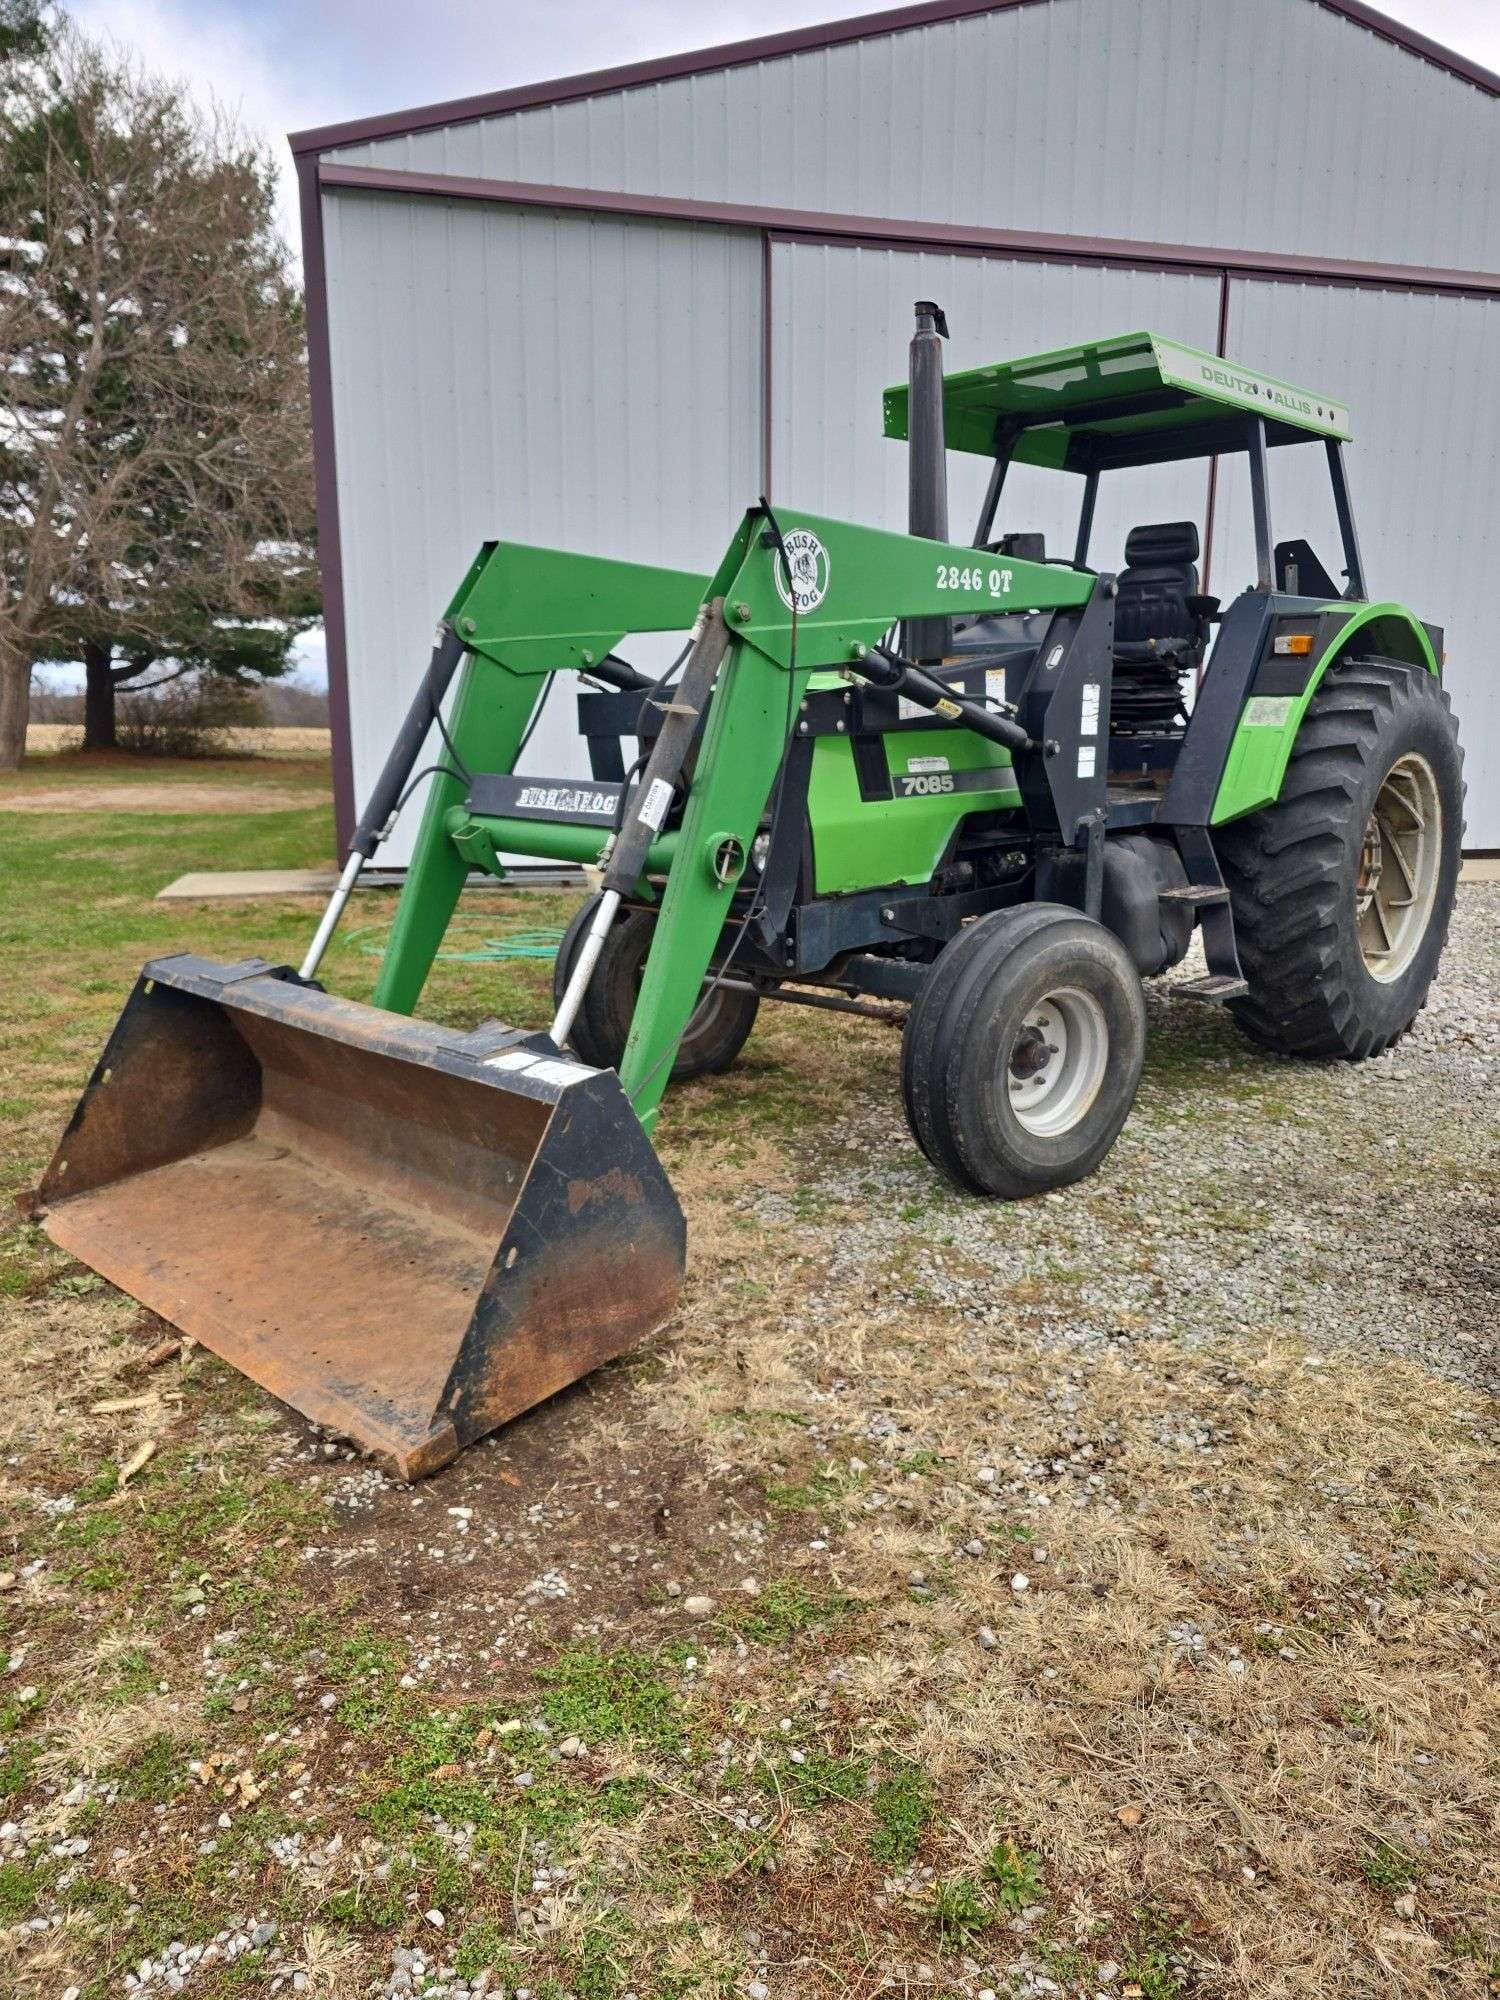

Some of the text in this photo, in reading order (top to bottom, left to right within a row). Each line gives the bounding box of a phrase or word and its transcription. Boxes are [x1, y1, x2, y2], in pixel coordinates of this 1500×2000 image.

[1202, 366, 1312, 415] DEUTZ ALLIS
[785, 535, 818, 555] BUSH
[936, 565, 1013, 598] 2846 QT
[791, 590, 818, 607] HOG
[902, 774, 954, 796] 7085
[516, 787, 558, 810] BUSH
